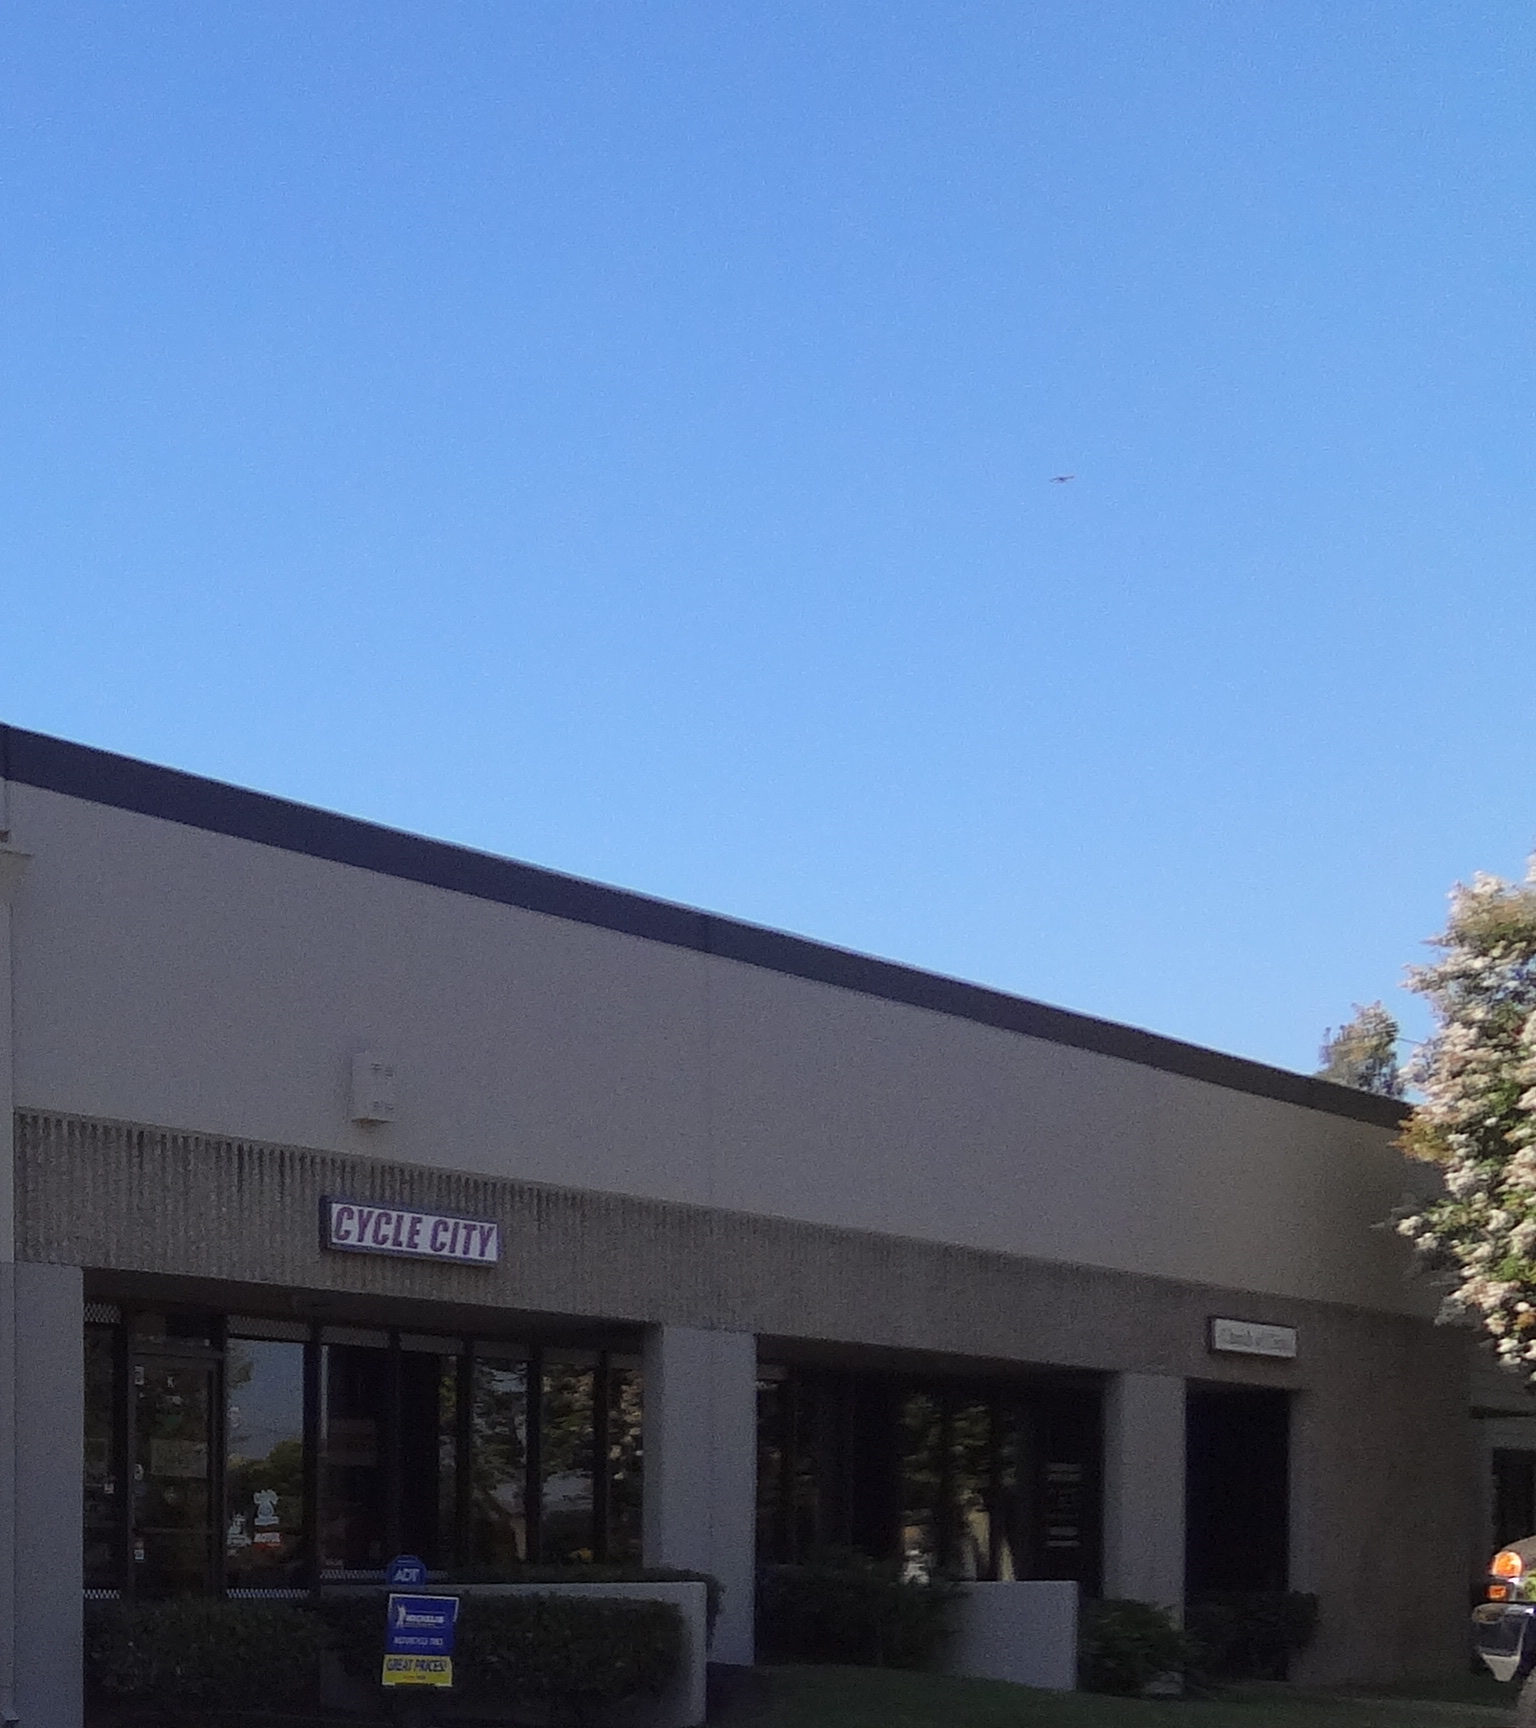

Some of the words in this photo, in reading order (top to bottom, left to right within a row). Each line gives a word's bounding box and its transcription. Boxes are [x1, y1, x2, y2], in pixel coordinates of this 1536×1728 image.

[334, 1206, 423, 1250] CYCLE
[430, 1218, 496, 1258] CITY
[393, 1568, 420, 1582] ADT
[386, 1658, 414, 1672] GREAT
